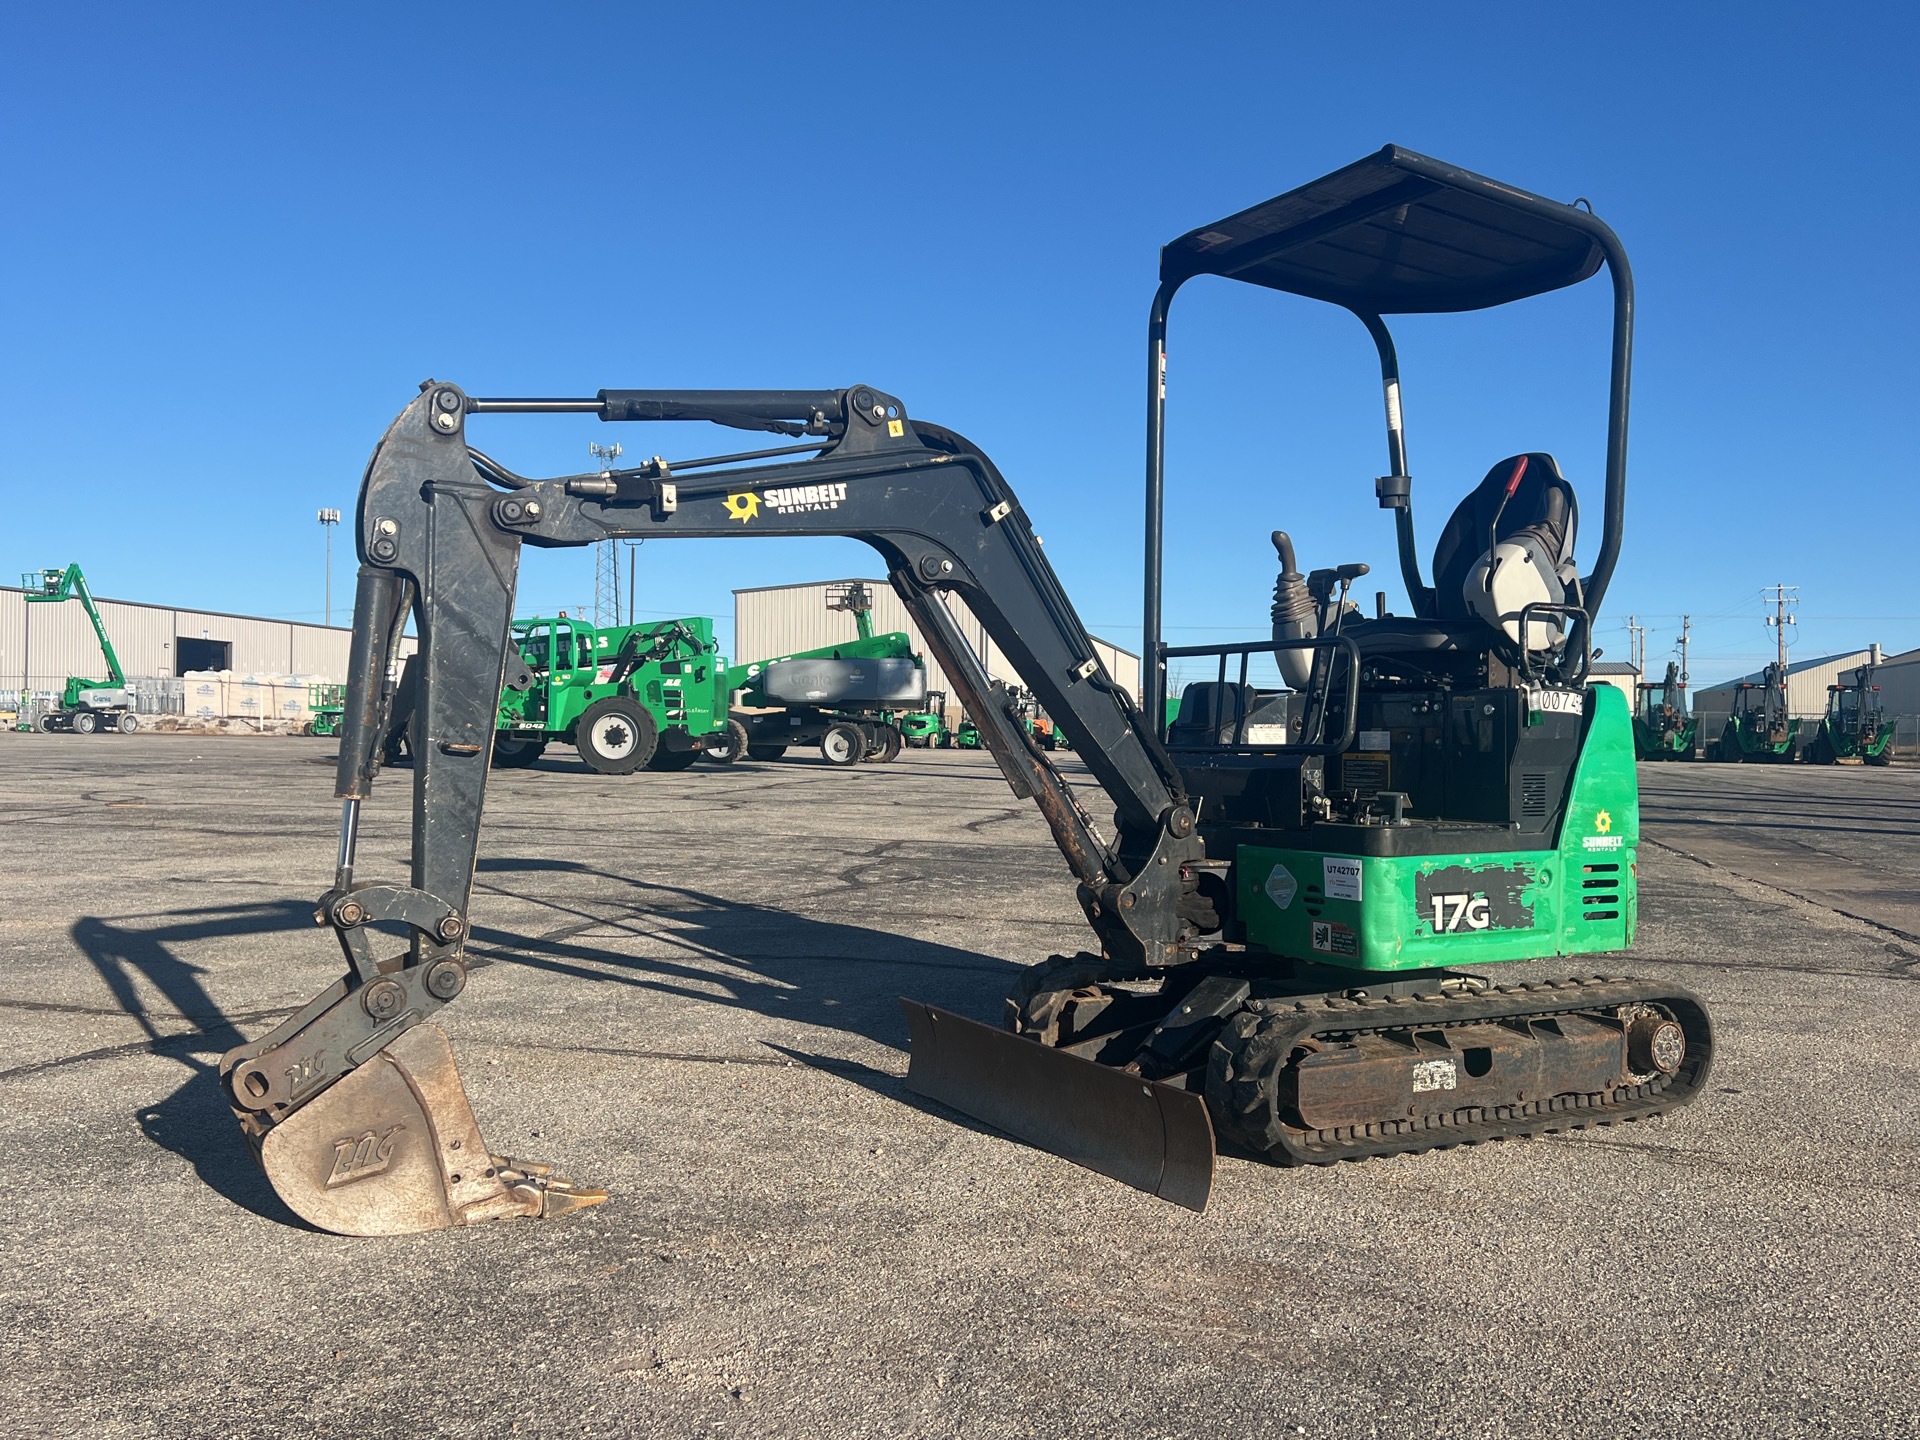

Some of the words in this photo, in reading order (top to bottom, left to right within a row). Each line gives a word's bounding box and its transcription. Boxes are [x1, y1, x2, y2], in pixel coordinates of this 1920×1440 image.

[763, 482, 847, 508] SUNBELT
[778, 501, 838, 515] RENTALS
[662, 678, 681, 687] JLG
[92, 695, 112, 703] Genie
[1582, 835, 1622, 848] SUNBELT
[1326, 865, 1360, 877] U742707
[1431, 894, 1489, 931] 17G
